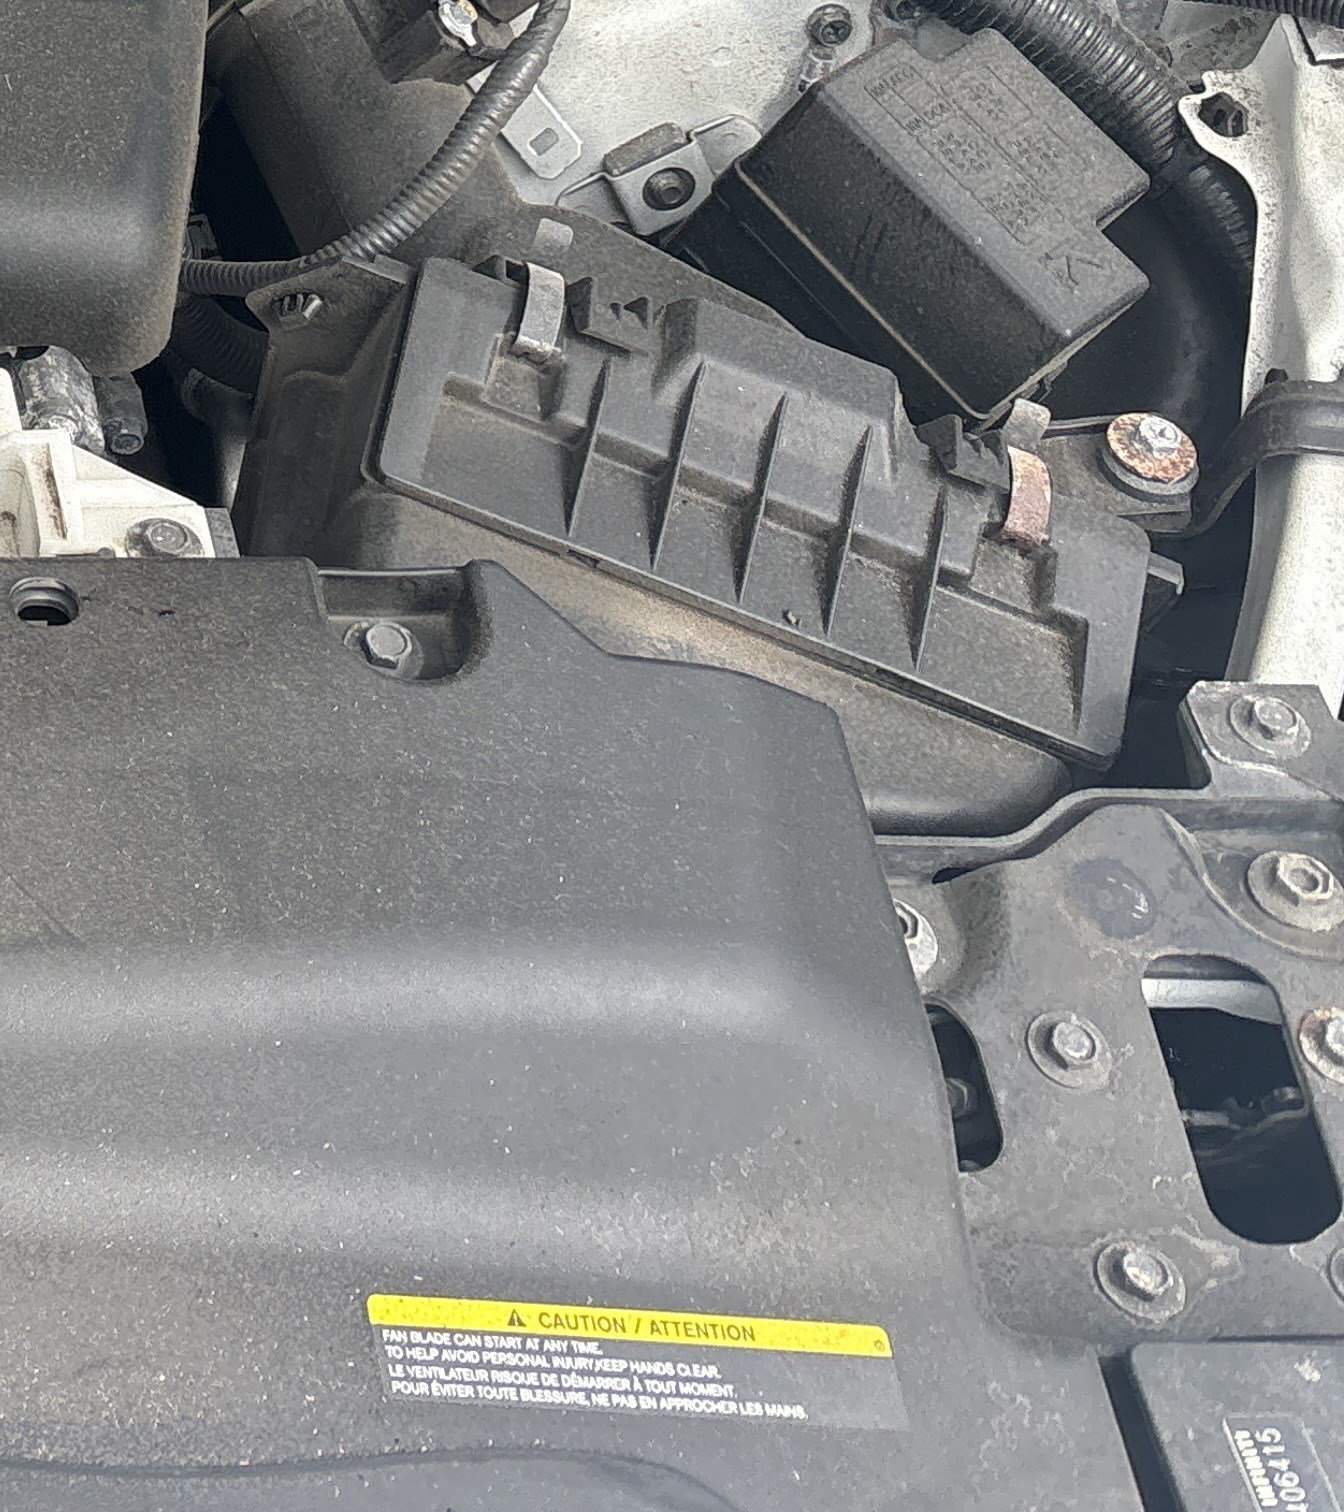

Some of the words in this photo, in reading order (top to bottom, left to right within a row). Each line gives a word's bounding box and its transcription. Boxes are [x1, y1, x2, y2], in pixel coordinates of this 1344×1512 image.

[538, 1311, 627, 1333] CAUTION
[649, 1319, 756, 1341] ATTENTION
[382, 1329, 408, 1345] FAN
[409, 1331, 451, 1346] BLADE
[453, 1332, 483, 1347] CAN
[484, 1334, 523, 1350] START
[525, 1337, 540, 1351] AT
[542, 1338, 570, 1354] ANY
[384, 1345, 404, 1359] TO
[405, 1346, 440, 1361] HELP
[441, 1348, 480, 1364] AVOID
[482, 1351, 551, 1368] PERSONAL
[630, 1361, 675, 1376] HANDS
[388, 1363, 405, 1378] LE
[541, 1372, 559, 1387] DE
[391, 1379, 430, 1396] POUR
[477, 1384, 518, 1401] TOUTE
[611, 1394, 638, 1409] PAS
[639, 1396, 658, 1411] EN
